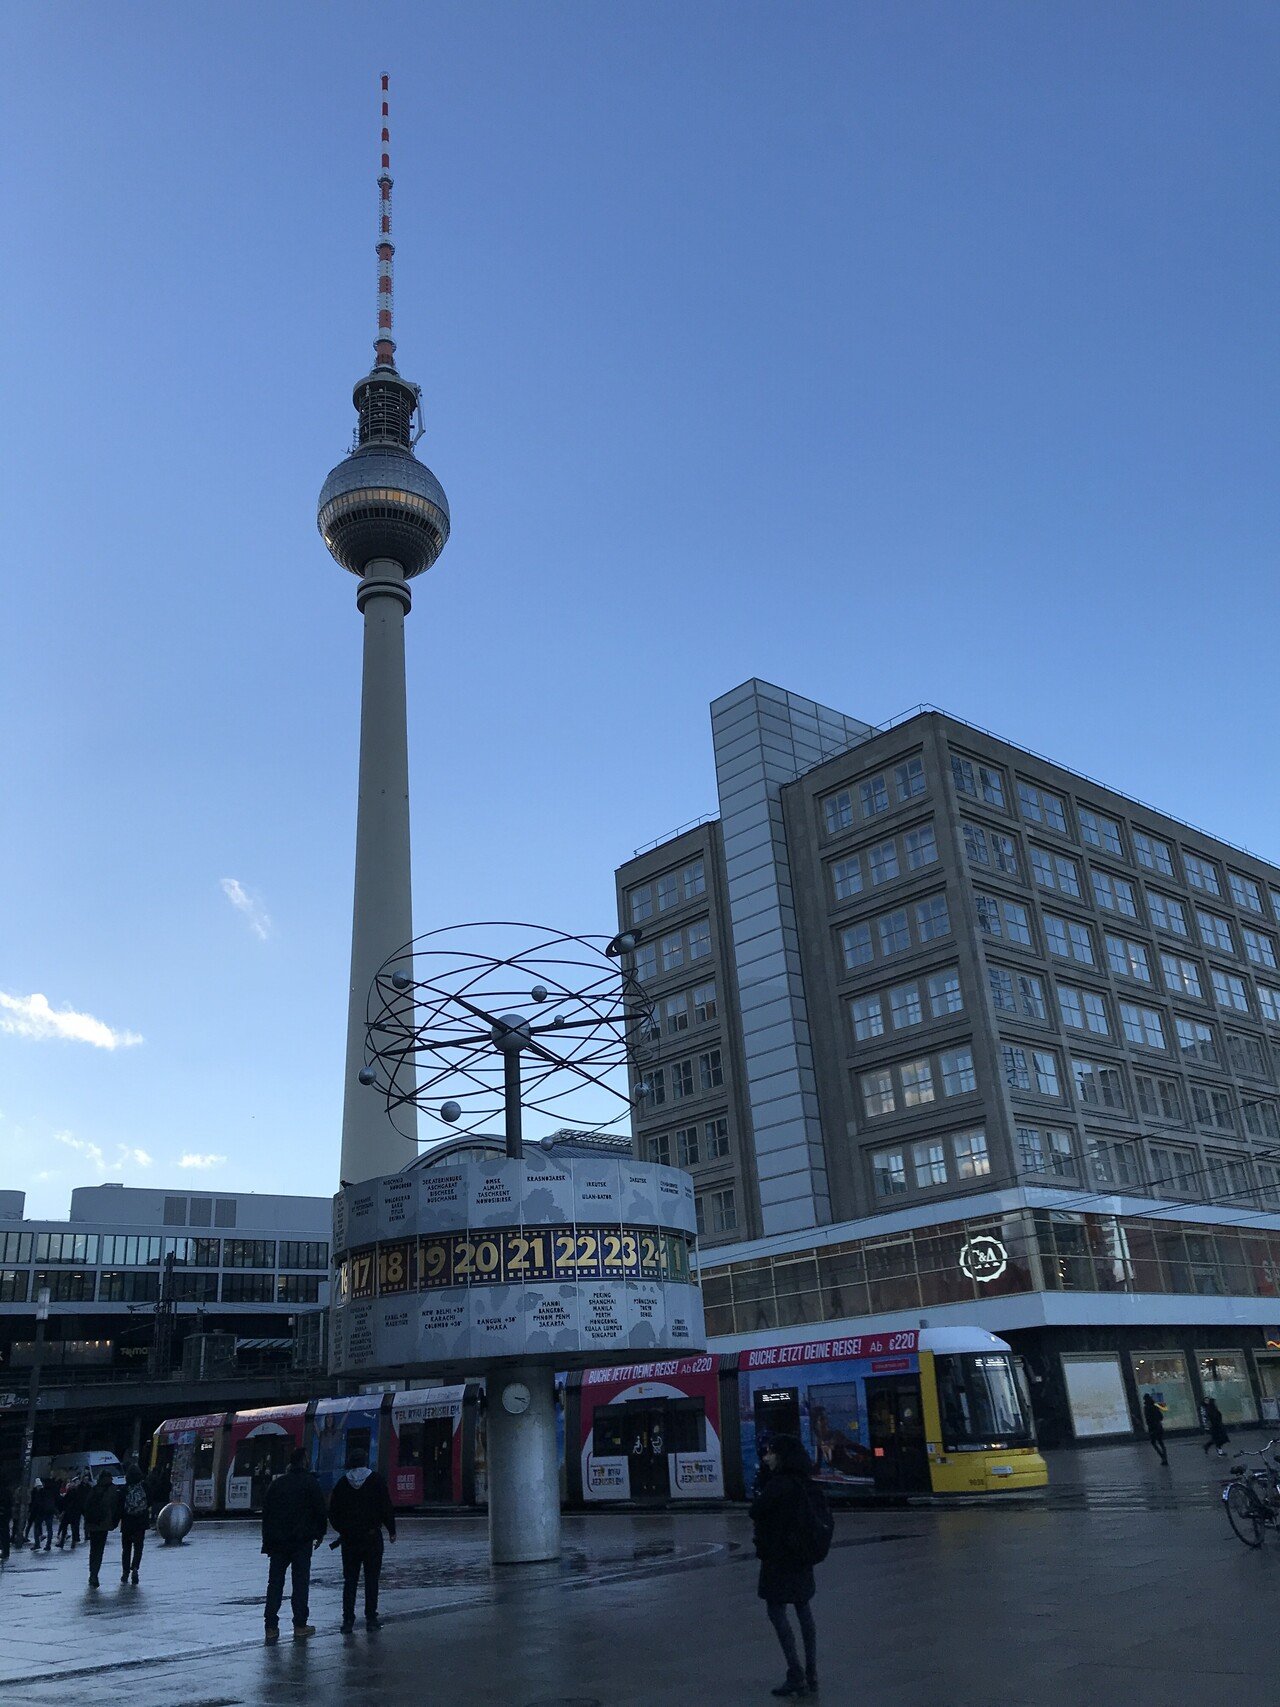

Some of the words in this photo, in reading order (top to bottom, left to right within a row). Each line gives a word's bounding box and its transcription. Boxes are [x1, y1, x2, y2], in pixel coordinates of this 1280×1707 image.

[353, 1258, 371, 1289] 17
[378, 1252, 403, 1284] 18
[414, 1246, 446, 1278] 19
[454, 1242, 499, 1274] 20
[508, 1238, 544, 1269] 21
[556, 1237, 598, 1267] 22
[604, 1237, 637, 1267] 23
[641, 1239, 667, 1268] 24
[749, 1350, 777, 1366] BUCHE
[778, 1346, 803, 1364] JETZT
[804, 1342, 830, 1360] DEINE
[832, 1339, 862, 1356] REISE!
[869, 1342, 882, 1352] Ab
[889, 1333, 914, 1350] €220
[588, 1370, 610, 1384] BUCHE
[611, 1366, 633, 1381] JETZT
[633, 1364, 654, 1379] DEINE
[655, 1361, 679, 1376] REISE!
[681, 1364, 691, 1374] Ab
[692, 1357, 712, 1372] €220
